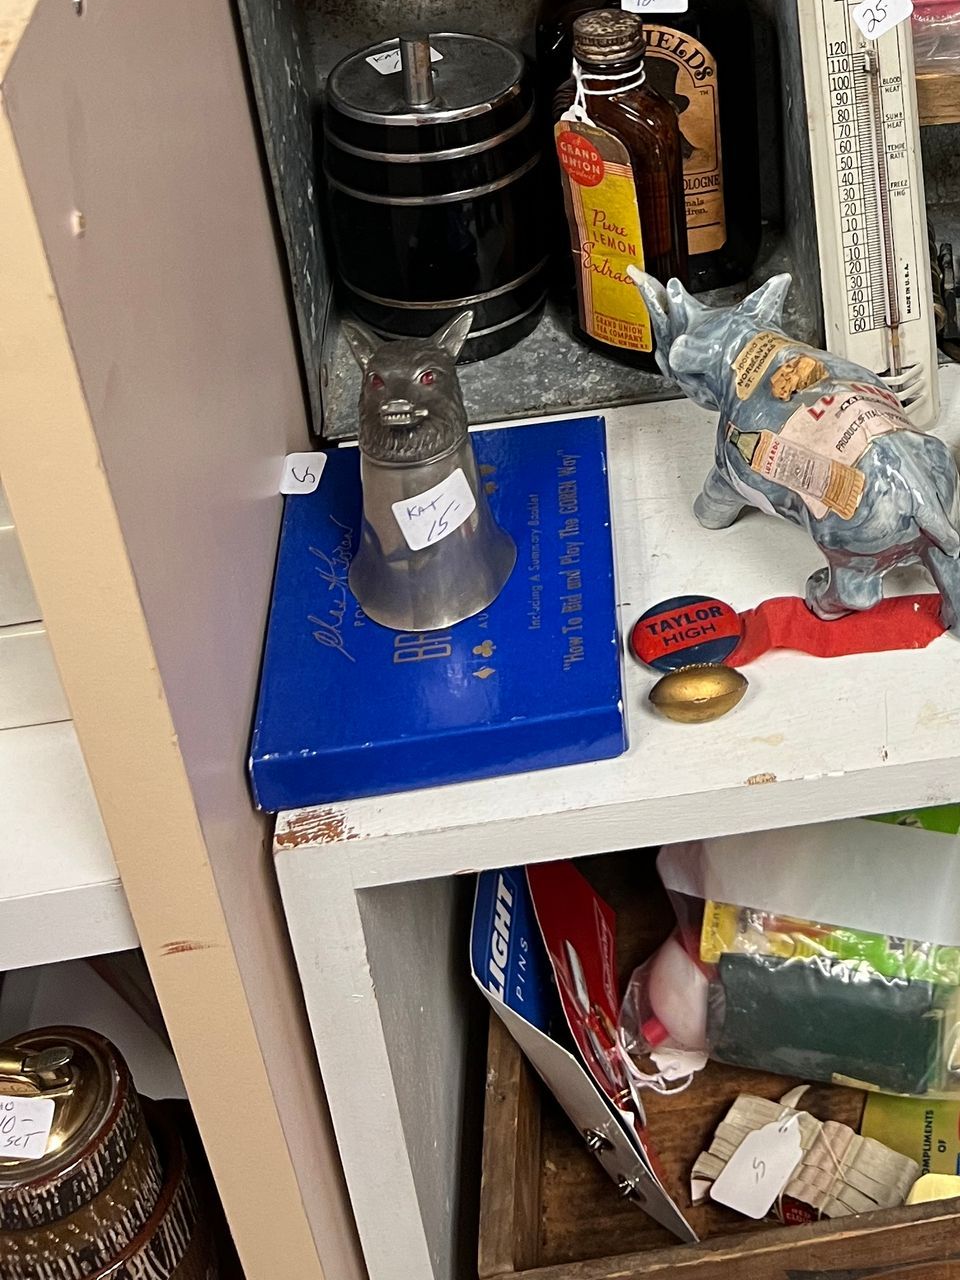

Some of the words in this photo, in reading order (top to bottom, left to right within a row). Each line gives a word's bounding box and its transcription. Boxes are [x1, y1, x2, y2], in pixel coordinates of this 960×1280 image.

[643, 29, 714, 82] IELDS
[828, 40, 848, 56] 120
[830, 57, 849, 73] 110
[831, 75, 850, 90] 100
[835, 91, 849, 106] 90
[837, 108, 851, 122] 80
[838, 124, 851, 138] 70
[560, 141, 598, 161] GRAND
[839, 140, 852, 153] 60
[561, 153, 601, 175] UNION
[840, 156, 853, 170] 50
[683, 174, 720, 190] OLOGNE
[841, 171, 854, 185] 40
[842, 187, 856, 201] 30
[844, 202, 857, 216] 20
[591, 208, 629, 238] Pure
[845, 217, 858, 232] 10
[592, 230, 637, 257] LEMON
[851, 232, 859, 246] 0
[848, 247, 861, 260] 10
[582, 241, 636, 287] Extrac
[849, 261, 862, 274] 20
[850, 276, 863, 289] 30
[851, 290, 864, 303] 40
[852, 304, 865, 317] 50
[904, 297, 912, 315] MADE
[595, 315, 617, 331] GRAND
[619, 323, 643, 336] UNION
[596, 324, 608, 335] TEA
[609, 328, 644, 343] COMPANY
[853, 318, 867, 332] 60
[753, 343, 777, 376] THOMAS
[835, 421, 861, 453] PRODUCT
[557, 480, 579, 515] GOREN
[528, 493, 541, 526] Booklet
[558, 517, 579, 538] The
[528, 528, 543, 572] Summary
[559, 541, 585, 566] Play
[560, 570, 581, 590] and
[528, 585, 544, 630] Including
[559, 593, 583, 614] Bid
[561, 617, 583, 634] To
[644, 604, 724, 637] TAYLOR
[662, 622, 718, 648] HIGH
[515, 936, 530, 1003] PINS
[937, 1138, 947, 1153] OF
